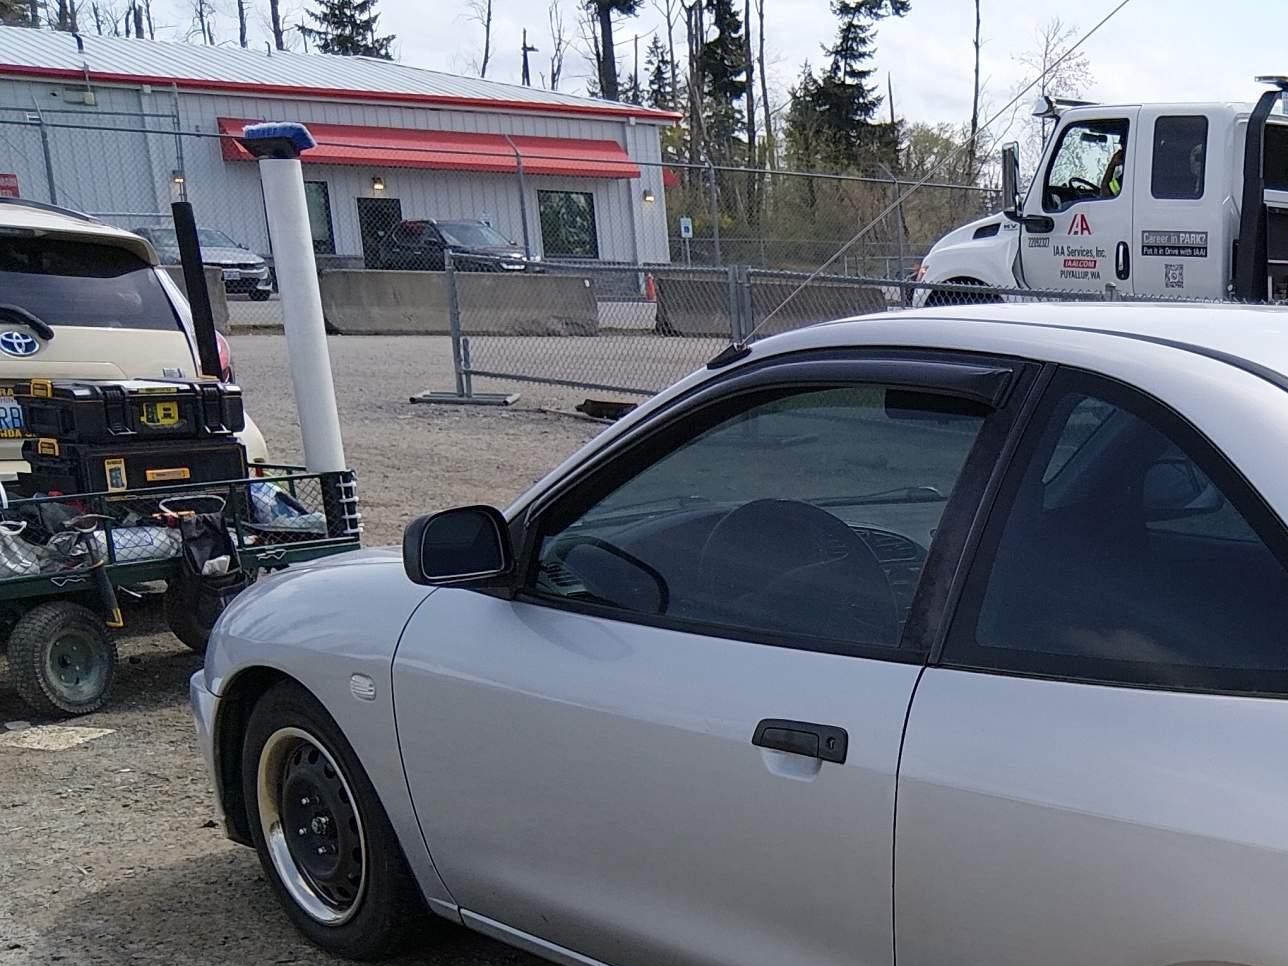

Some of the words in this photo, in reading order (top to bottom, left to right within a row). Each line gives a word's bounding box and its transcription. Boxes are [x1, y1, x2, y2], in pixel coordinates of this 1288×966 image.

[1143, 232, 1169, 243] Career
[1170, 233, 1178, 244] in
[1179, 233, 1206, 245] PARK?
[1053, 245, 1066, 257] IAA
[1066, 245, 1095, 259] Services,
[1095, 246, 1107, 258] Inc.
[1090, 271, 1101, 279] WA
